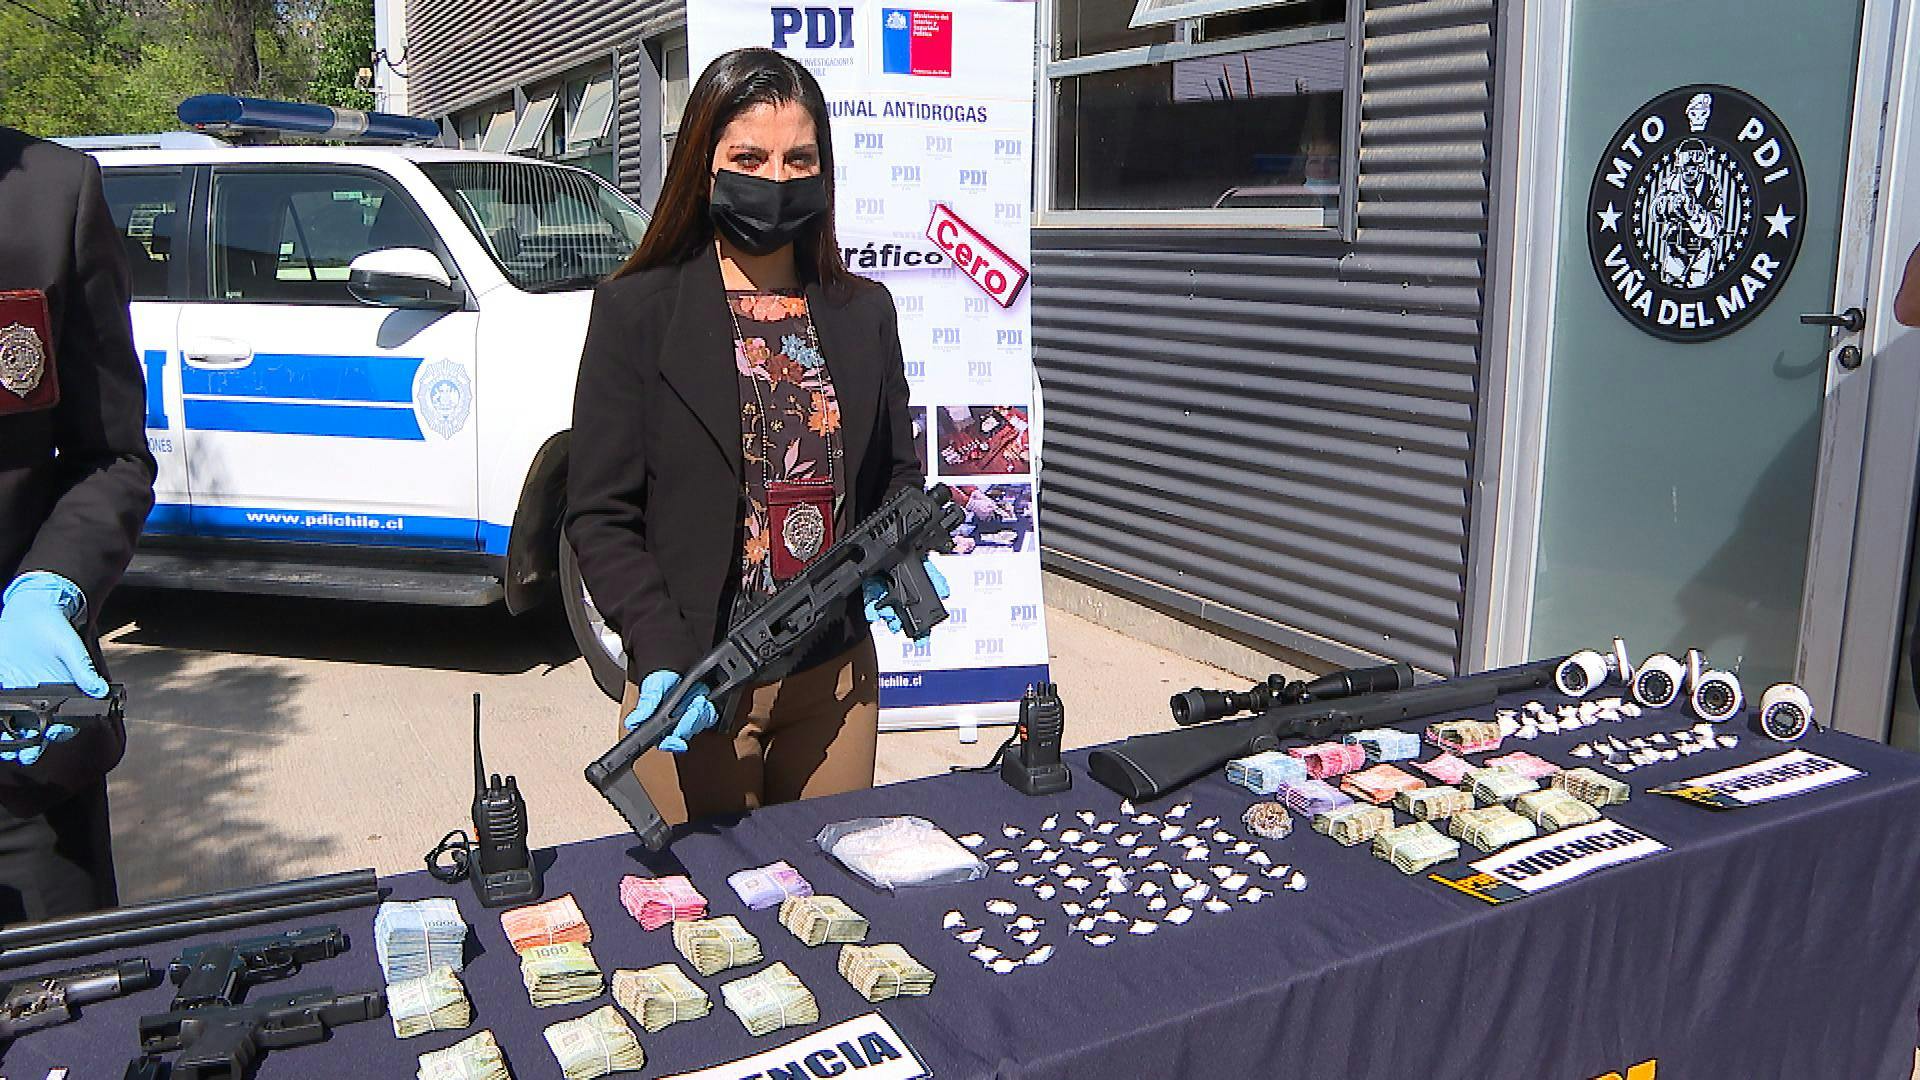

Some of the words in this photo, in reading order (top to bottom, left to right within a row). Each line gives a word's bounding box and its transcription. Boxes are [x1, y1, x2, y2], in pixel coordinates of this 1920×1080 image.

[771, 7, 854, 48] PDI
[883, 101, 988, 123] ANTIDROGAS
[854, 133, 884, 149] PDI
[926, 135, 953, 152] PDI
[994, 139, 1022, 155] PDI
[1605, 116, 1664, 189] MTO
[1737, 118, 1789, 184] PDI
[891, 165, 921, 181] PDI
[959, 169, 988, 185] PDI
[855, 199, 884, 215] PDI
[993, 203, 1022, 219] PDI
[937, 219, 1007, 296] Cero
[1604, 244, 1653, 317] VIÑA
[1657, 299, 1715, 329] DEL
[1715, 252, 1780, 319] MAR
[932, 327, 961, 345] PDI
[996, 329, 1023, 345] PDI
[967, 361, 992, 377] PDI
[246, 511, 404, 530] www.pdichile.cl
[974, 569, 1004, 587] PDI
[1010, 604, 1038, 622] PDI
[975, 638, 1004, 655] PDI
[1493, 829, 1648, 881] EVIDENCIA
